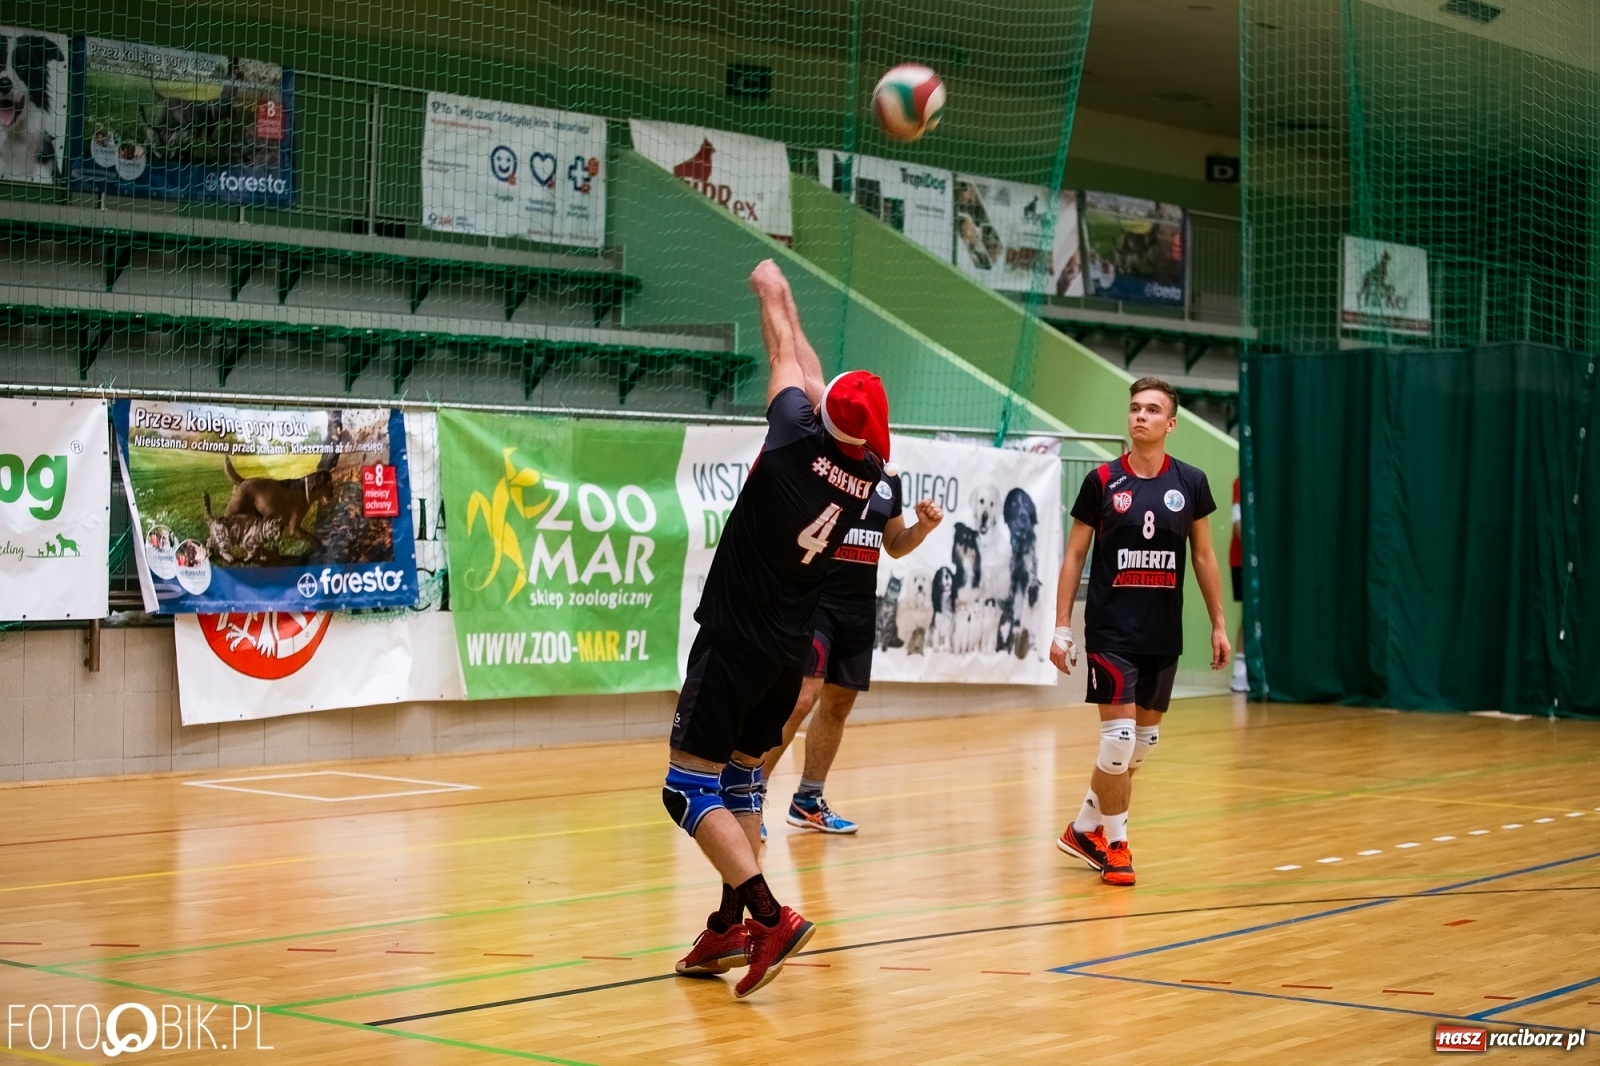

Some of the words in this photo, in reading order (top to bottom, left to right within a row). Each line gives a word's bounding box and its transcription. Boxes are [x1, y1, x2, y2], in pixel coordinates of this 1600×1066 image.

[1213, 165, 1234, 179] D
[135, 408, 182, 430] Przez
[186, 410, 242, 438] kolejne
[243, 418, 273, 440] pory
[278, 418, 309, 437] roku
[134, 435, 188, 450] Nieustanna
[191, 438, 229, 452] ochrona
[232, 440, 255, 455] przed
[375, 464, 384, 486] 8
[693, 462, 751, 502] WSZ
[535, 479, 657, 533] ZOO
[796, 502, 843, 566] 4
[1142, 510, 1156, 540] 8
[528, 533, 655, 586] MAR
[1117, 548, 1177, 570] OMERTA
[529, 588, 564, 609] sklep
[568, 589, 653, 610] zoologiczny
[466, 630, 650, 666] WWW.ZOO-MAR.PL
